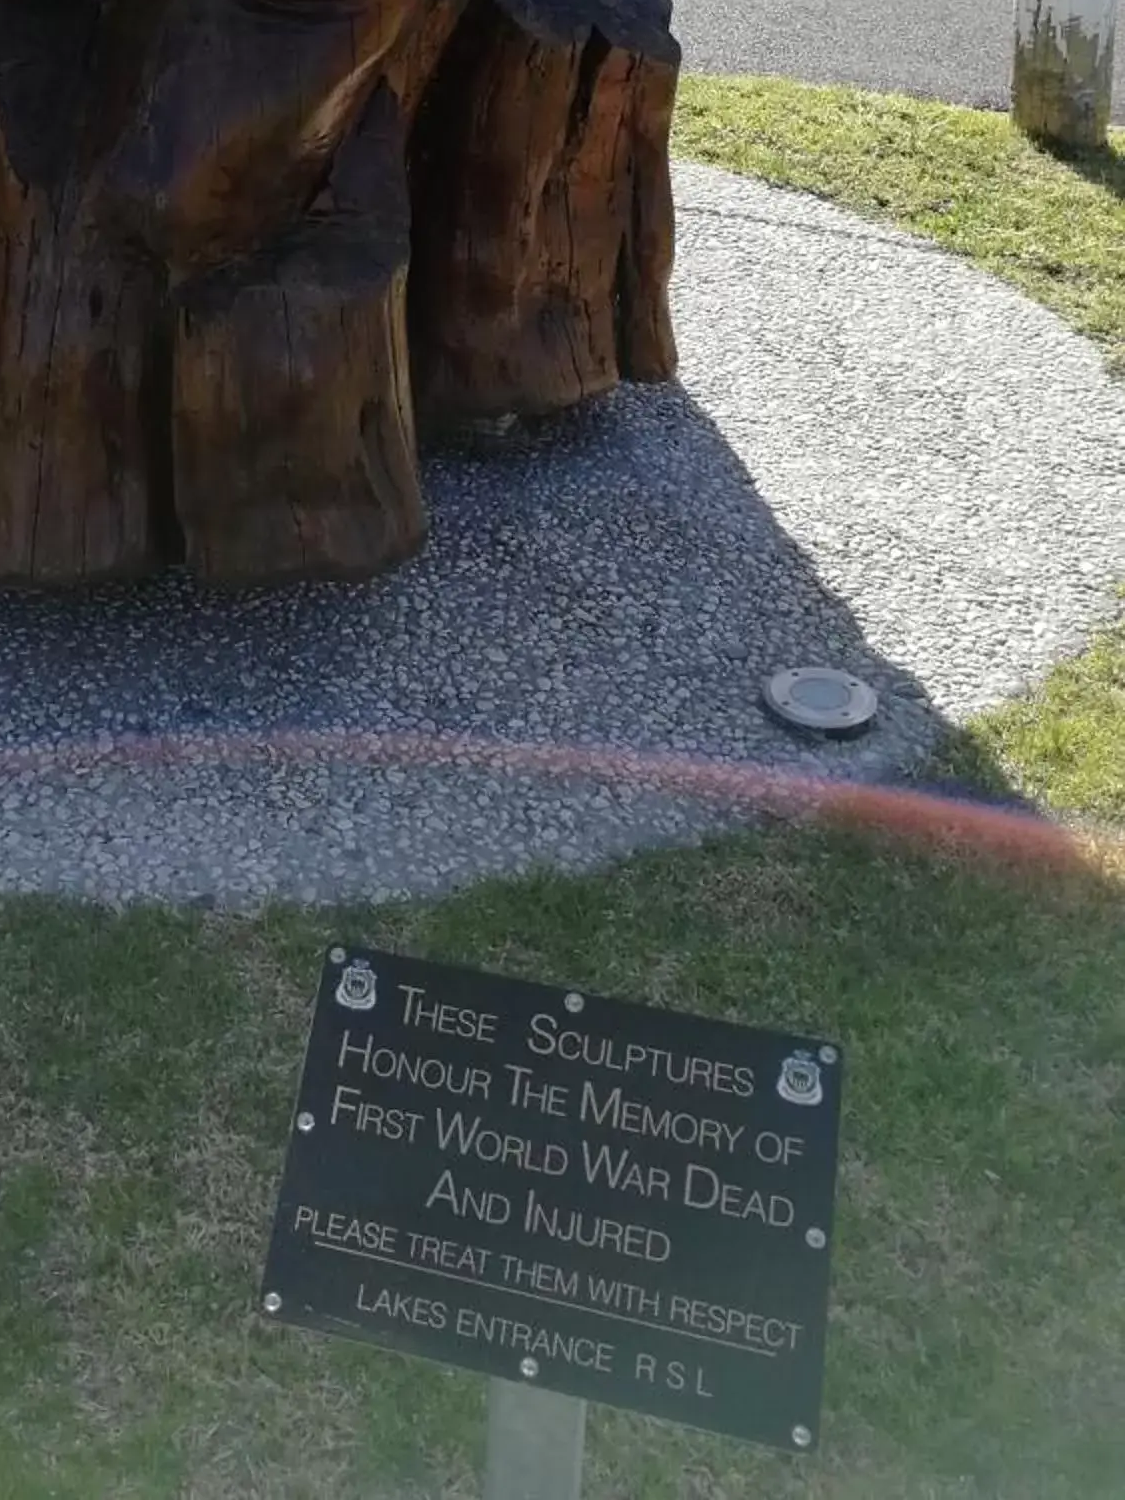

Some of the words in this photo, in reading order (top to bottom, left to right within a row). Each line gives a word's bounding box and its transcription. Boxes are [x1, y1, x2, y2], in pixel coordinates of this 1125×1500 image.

[338, 1029, 492, 1100] HONOUR
[504, 1063, 570, 1117] THE
[579, 1080, 745, 1153] MEMORY
[755, 1131, 805, 1165] OF
[397, 984, 499, 1043] THESE
[527, 1013, 755, 1097] SCULPTURES
[330, 1085, 424, 1143] FIRST
[436, 1107, 569, 1176] WORLD
[582, 1140, 671, 1200] WAR
[684, 1163, 795, 1228] DEAD
[425, 1169, 511, 1224] AND
[524, 1188, 671, 1262] INJURED
[294, 1205, 397, 1254] PLEASE
[407, 1232, 492, 1276] TREAT
[500, 1255, 577, 1297] THEM
[588, 1275, 660, 1317] WITH
[670, 1296, 804, 1350] RESPECT
[356, 1283, 447, 1330] LAKES
[456, 1309, 615, 1372] ENTRANCE
